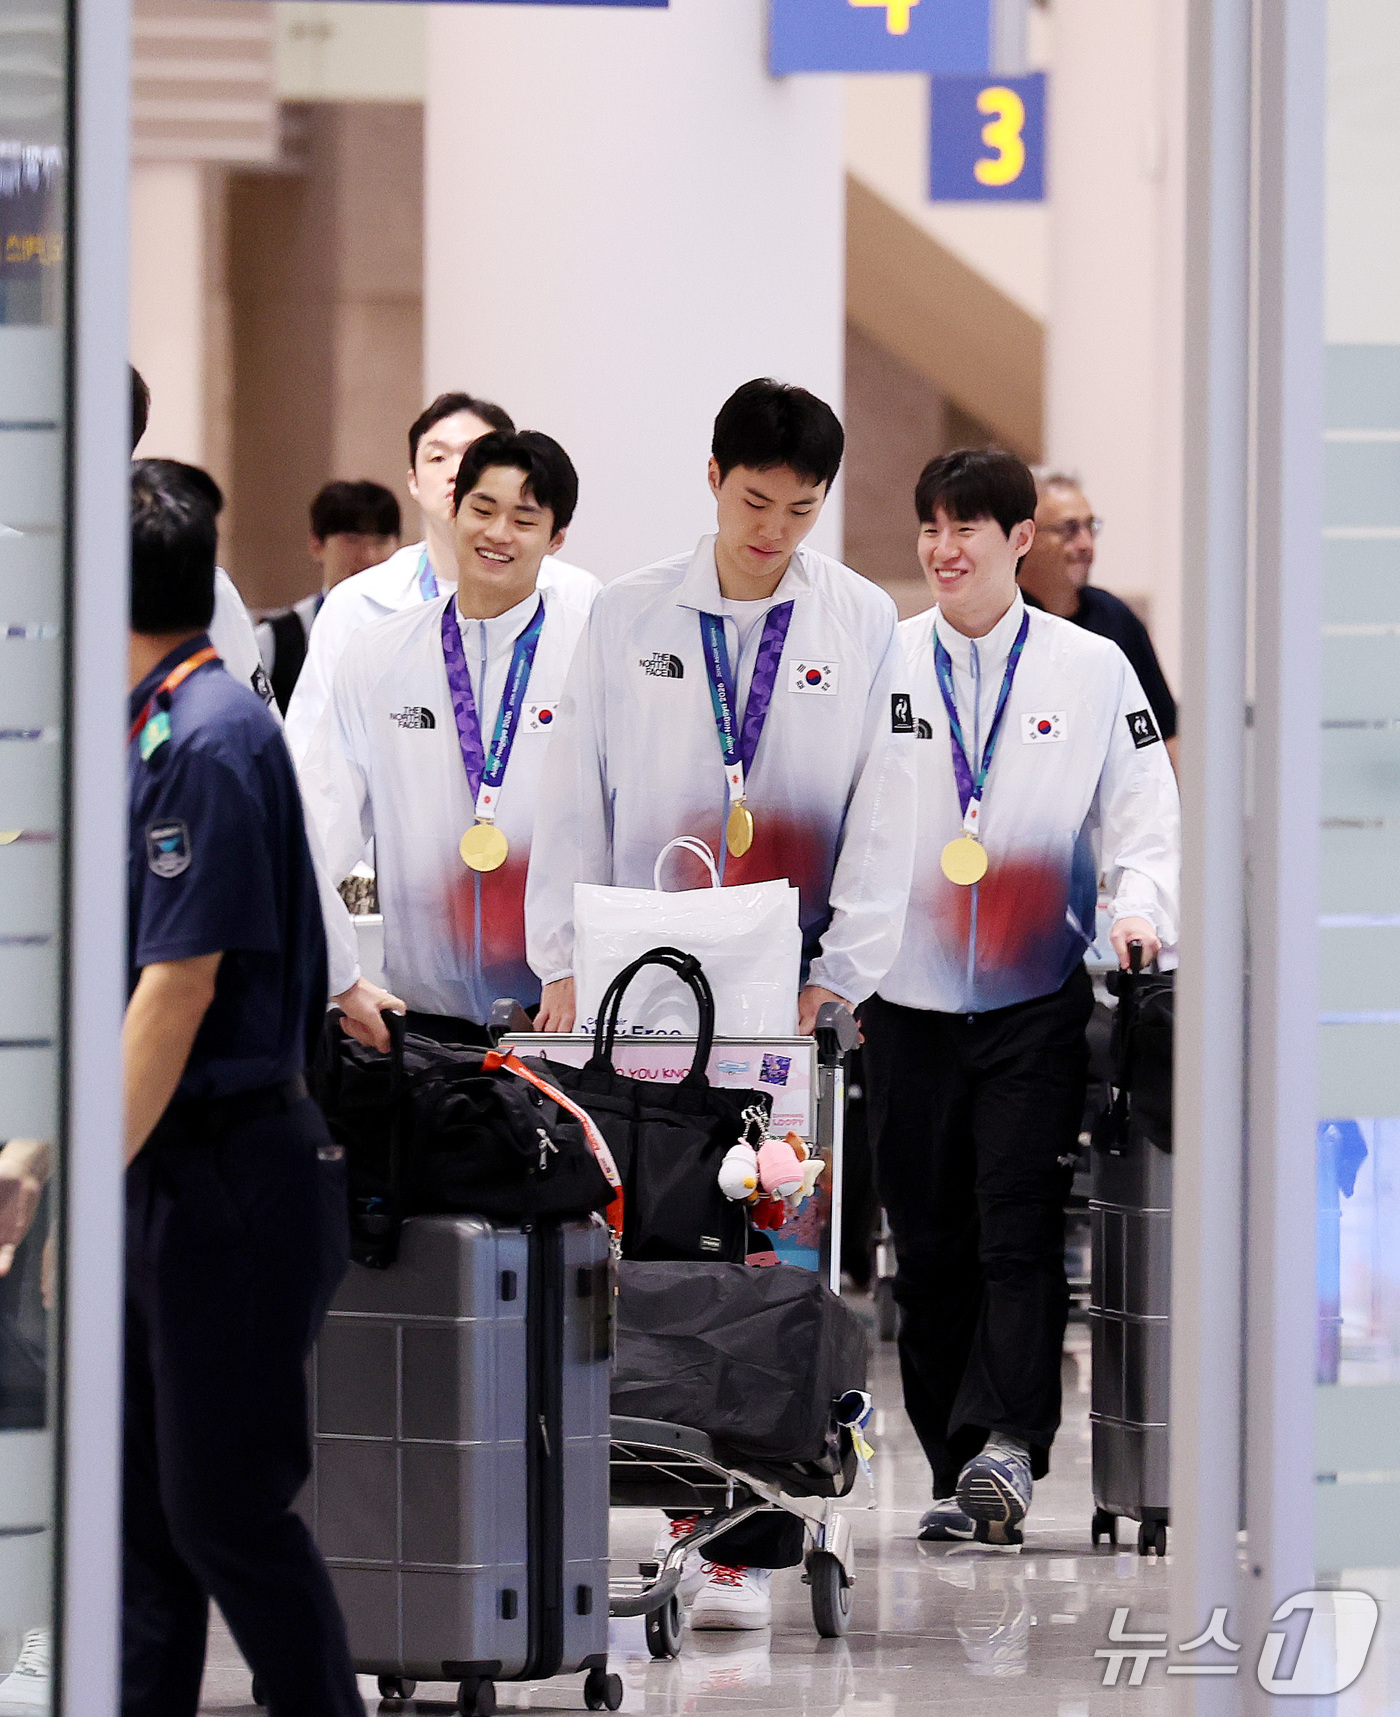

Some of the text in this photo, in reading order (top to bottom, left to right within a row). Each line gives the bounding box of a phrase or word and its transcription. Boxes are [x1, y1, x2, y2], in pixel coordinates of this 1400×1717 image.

[974, 86, 1026, 186] 3
[652, 652, 670, 661] THE
[639, 659, 669, 669] NORTH
[646, 668, 668, 677] FACE
[717, 682, 727, 703] 2026
[403, 706, 420, 714] THE
[398, 721, 420, 729] FACE
[629, 1068, 658, 1079] YOU
[663, 1067, 692, 1079] KNO
